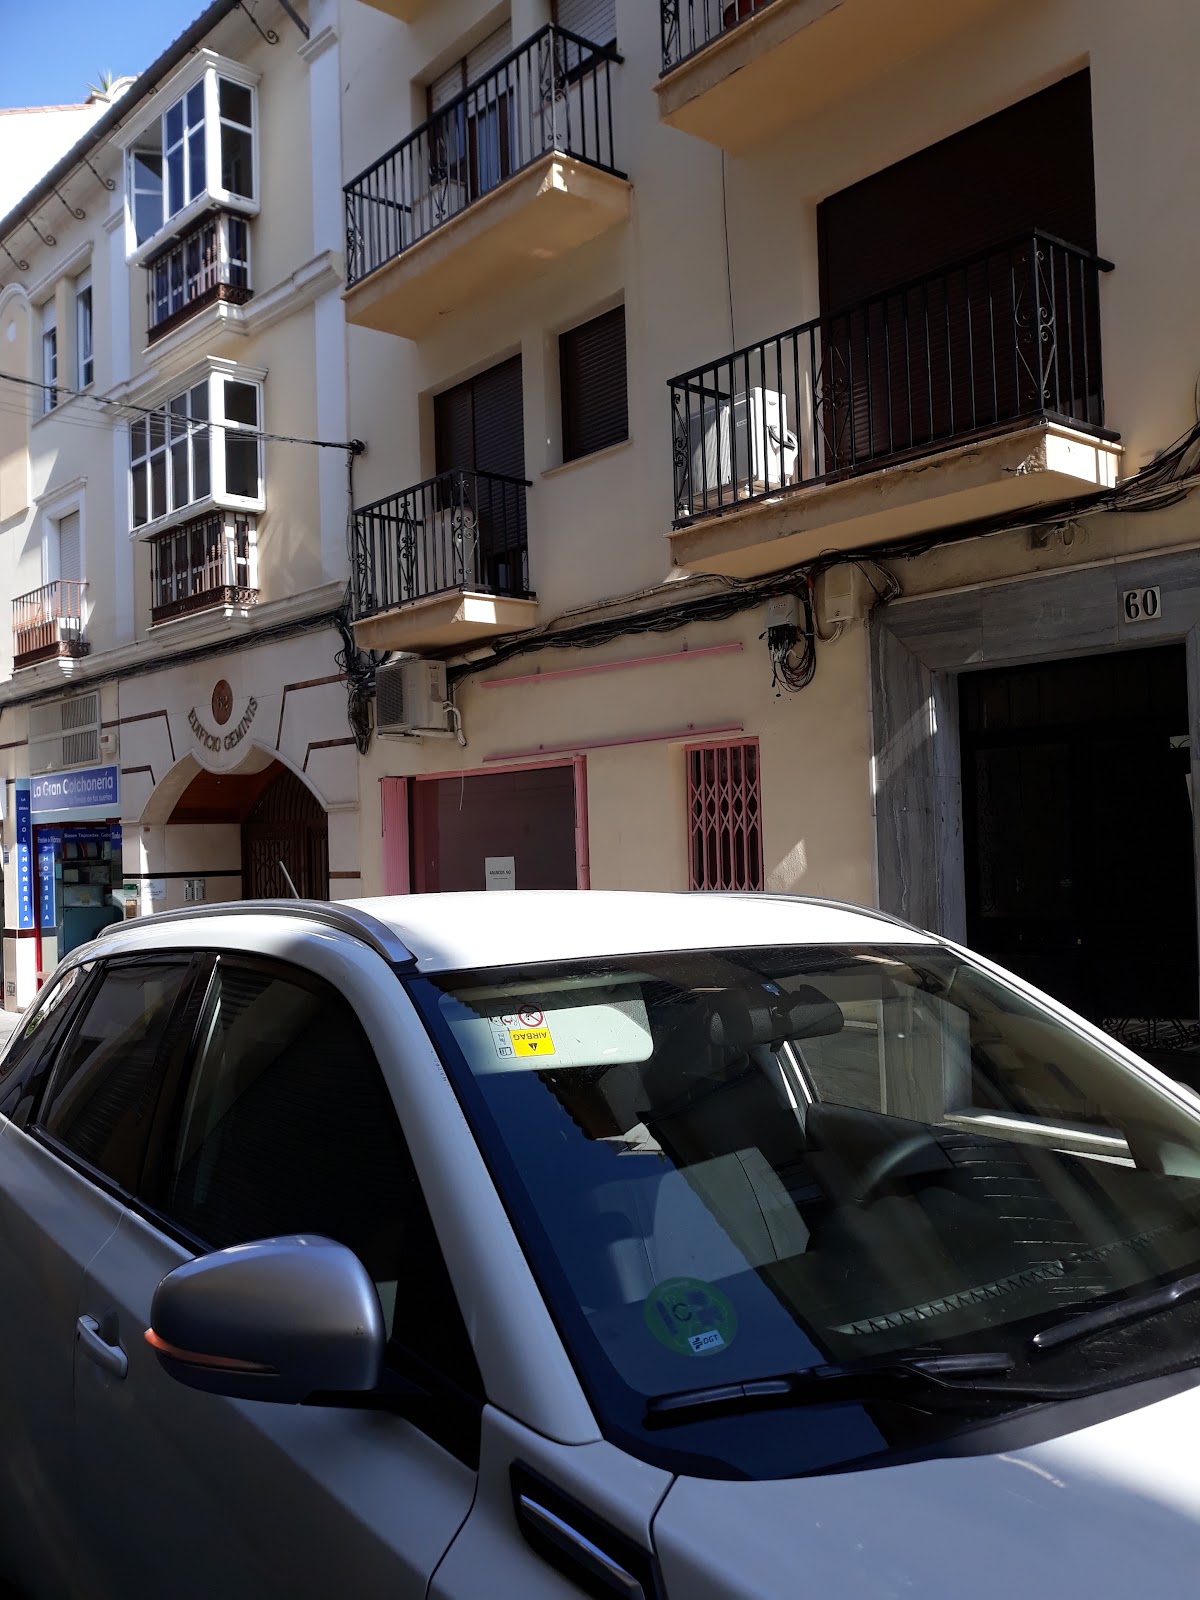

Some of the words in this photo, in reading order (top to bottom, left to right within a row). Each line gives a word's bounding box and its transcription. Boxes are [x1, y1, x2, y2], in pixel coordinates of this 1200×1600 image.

[1124, 589, 1158, 620] 60
[188, 707, 221, 752] EDIFICIO
[223, 697, 258, 751] GEMINIS
[33, 783, 42, 798] La
[42, 781, 62, 796] Gran
[62, 771, 113, 794] Colchonería
[512, 1032, 547, 1041] AIRBAG
[703, 1334, 718, 1344] DGT
